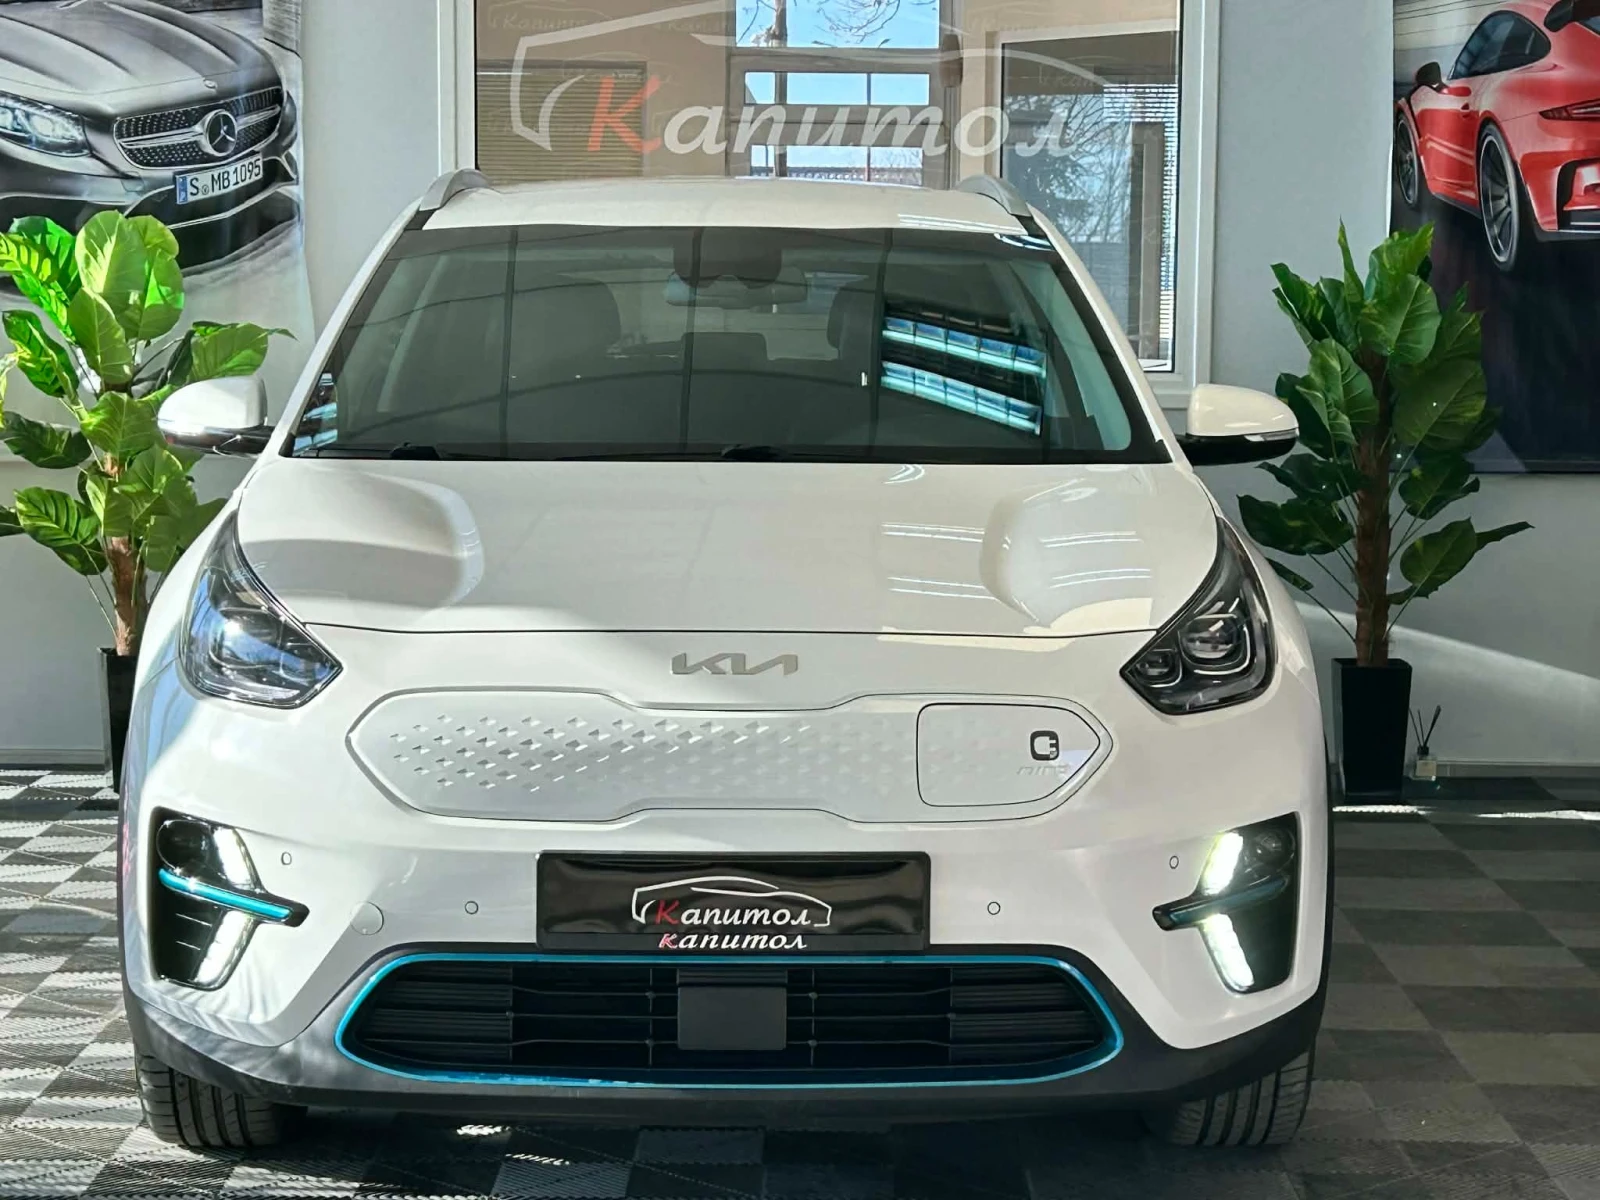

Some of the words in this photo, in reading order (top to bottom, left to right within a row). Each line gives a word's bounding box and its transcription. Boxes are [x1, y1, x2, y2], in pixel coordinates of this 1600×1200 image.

[587, 73, 1078, 156] Капитол
[189, 177, 199, 197] S
[654, 900, 811, 926] Капитол
